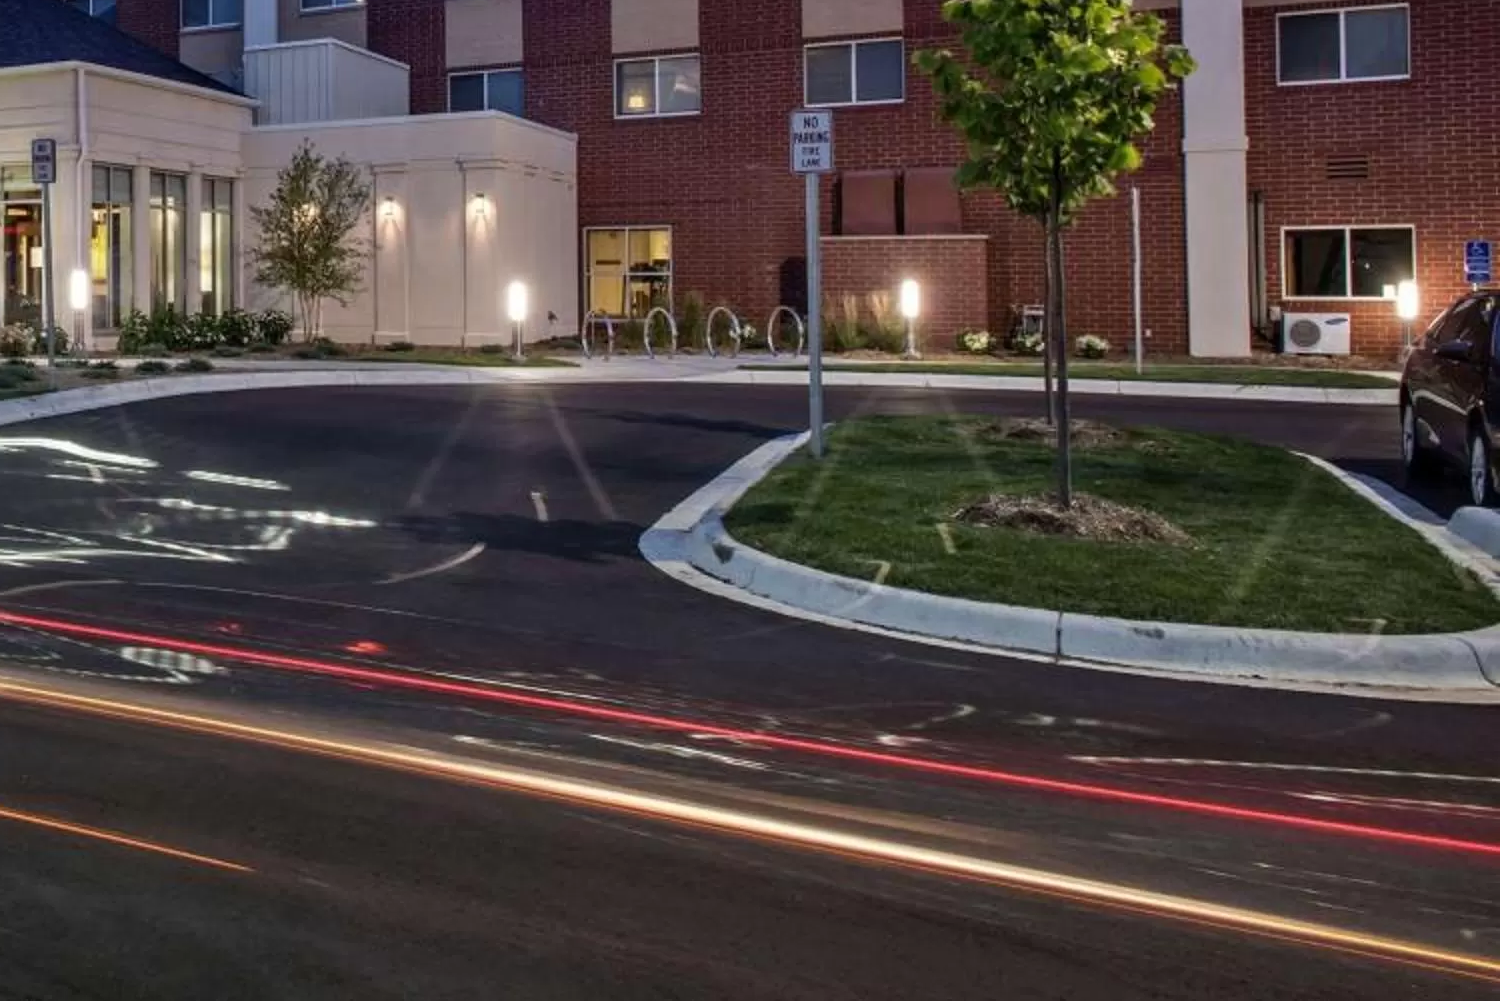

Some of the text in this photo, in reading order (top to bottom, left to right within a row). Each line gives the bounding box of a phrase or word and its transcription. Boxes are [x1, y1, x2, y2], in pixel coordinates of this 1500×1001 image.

[803, 115, 819, 129] NO
[793, 130, 829, 144] PARKING
[801, 158, 820, 168] LANE
